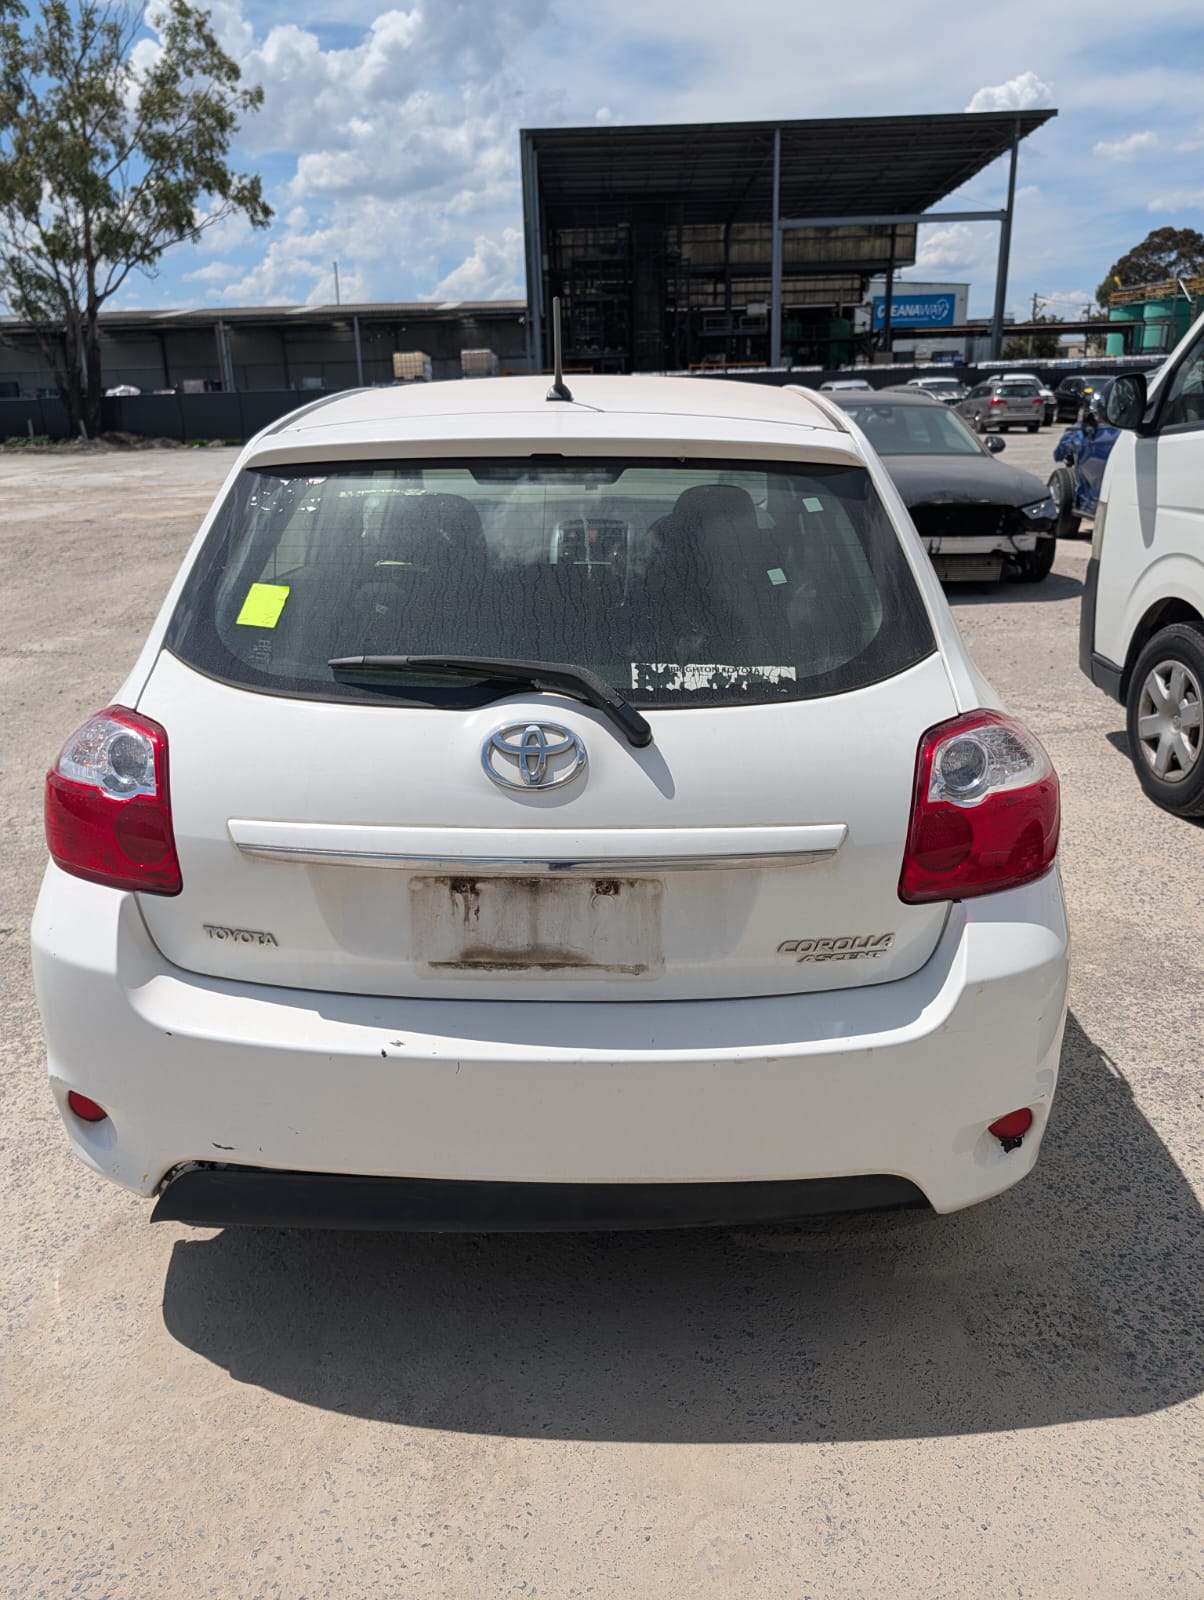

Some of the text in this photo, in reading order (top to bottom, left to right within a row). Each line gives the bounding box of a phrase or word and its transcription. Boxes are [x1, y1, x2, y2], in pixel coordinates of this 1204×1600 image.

[877, 302, 946, 319] CEANAWAY
[203, 924, 278, 947] TOYOTA
[777, 932, 895, 953] COROLLA
[797, 949, 887, 962] ASCENT
